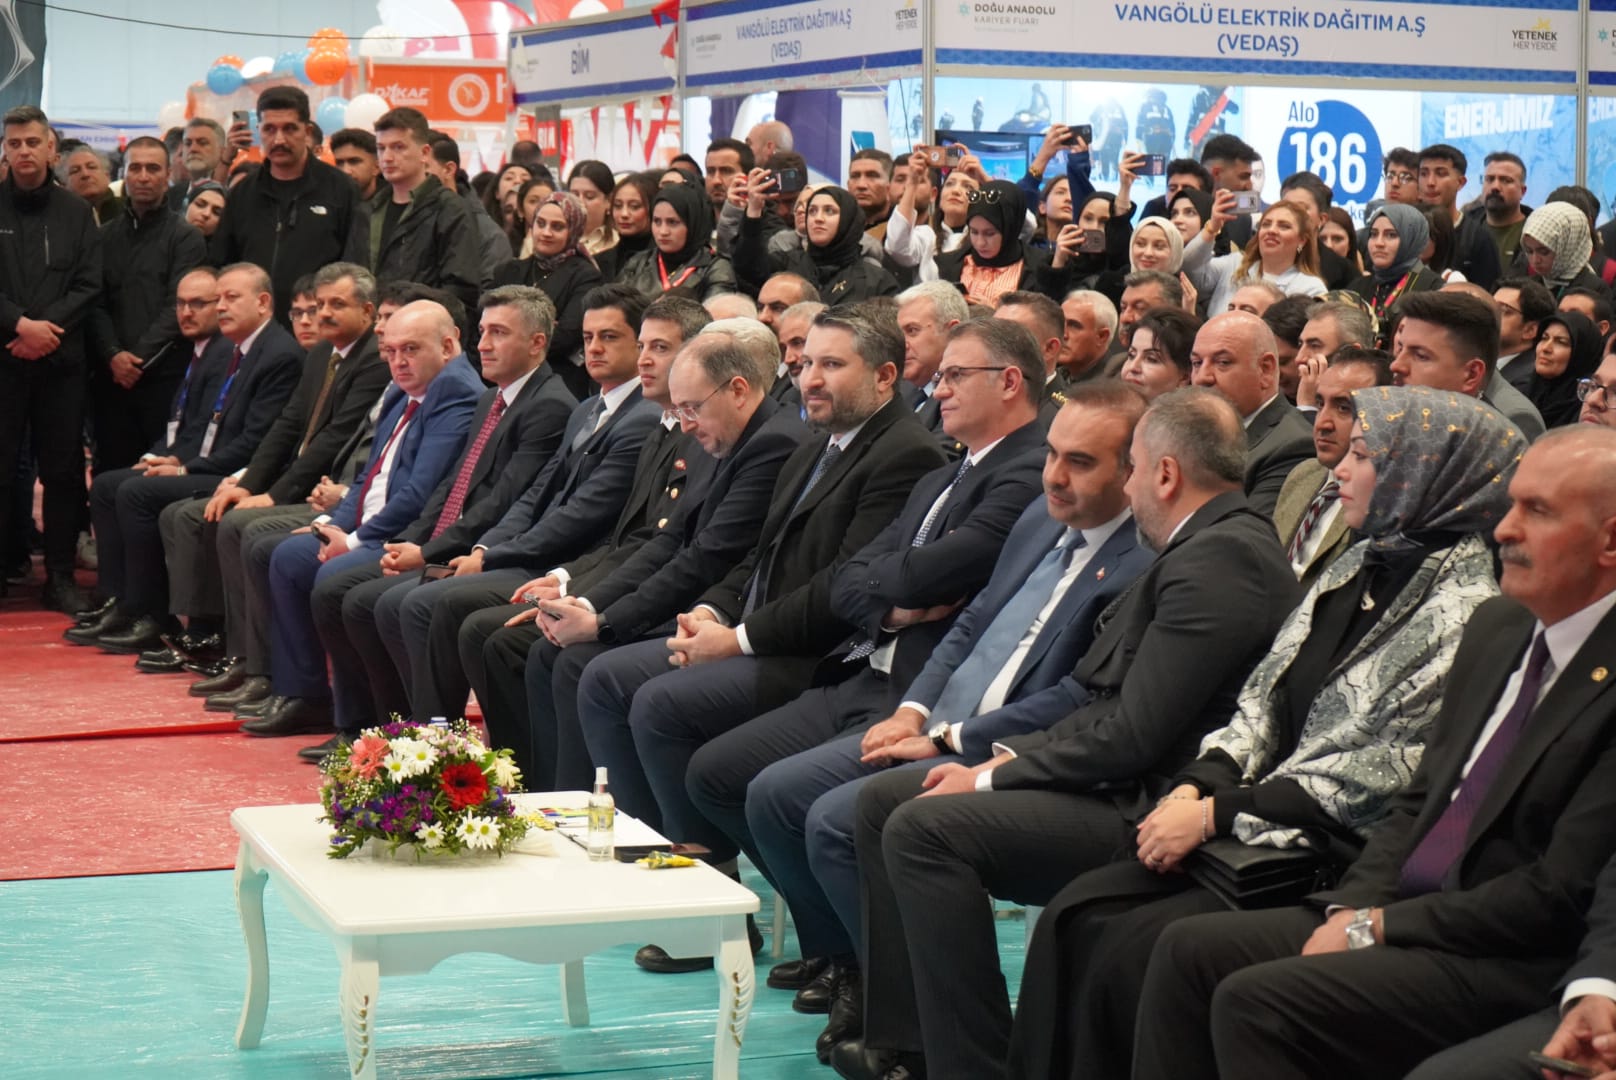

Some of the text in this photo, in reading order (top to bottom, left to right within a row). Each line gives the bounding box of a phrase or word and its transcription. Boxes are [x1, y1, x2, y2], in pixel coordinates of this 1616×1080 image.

[974, 3, 1056, 15] DOĞU ANADOLU
[1115, 2, 1426, 38] VANGÖLÜ ELEKTRİK DAĞITIM A.Ş
[1217, 33, 1299, 57] (VEDAŞ)
[1512, 30, 1558, 41] YETENEK
[1513, 41, 1557, 51] HER YERDE
[571, 42, 590, 75] BİM
[771, 40, 801, 62] (VEDAŞ)
[1288, 101, 1315, 122] Alo
[1289, 131, 1367, 194] 186
